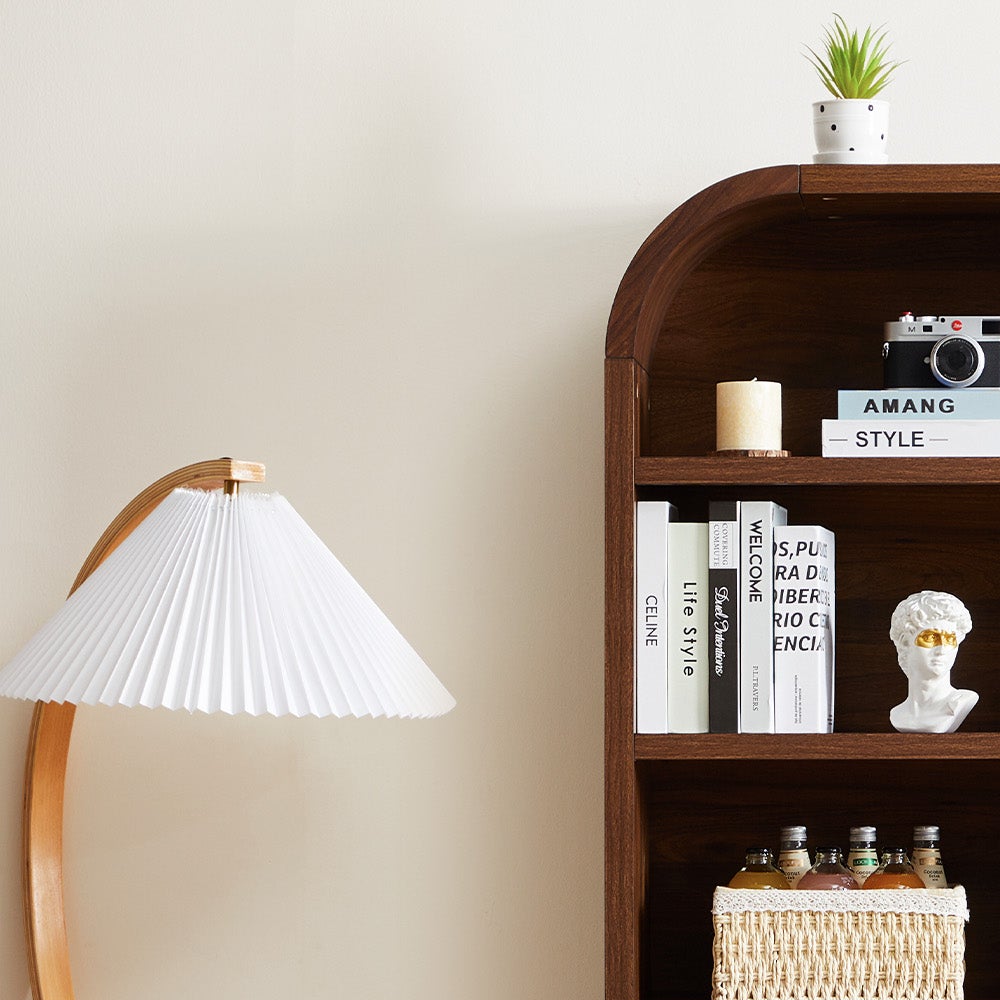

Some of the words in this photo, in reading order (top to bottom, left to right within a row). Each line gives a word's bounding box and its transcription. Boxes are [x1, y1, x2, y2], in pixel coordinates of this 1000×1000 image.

[863, 398, 955, 414] AMANG
[855, 430, 925, 448] STYLE
[749, 519, 763, 603] WELCOME
[683, 582, 697, 617] Life
[645, 595, 658, 647] CELINE
[680, 627, 697, 677] Style
